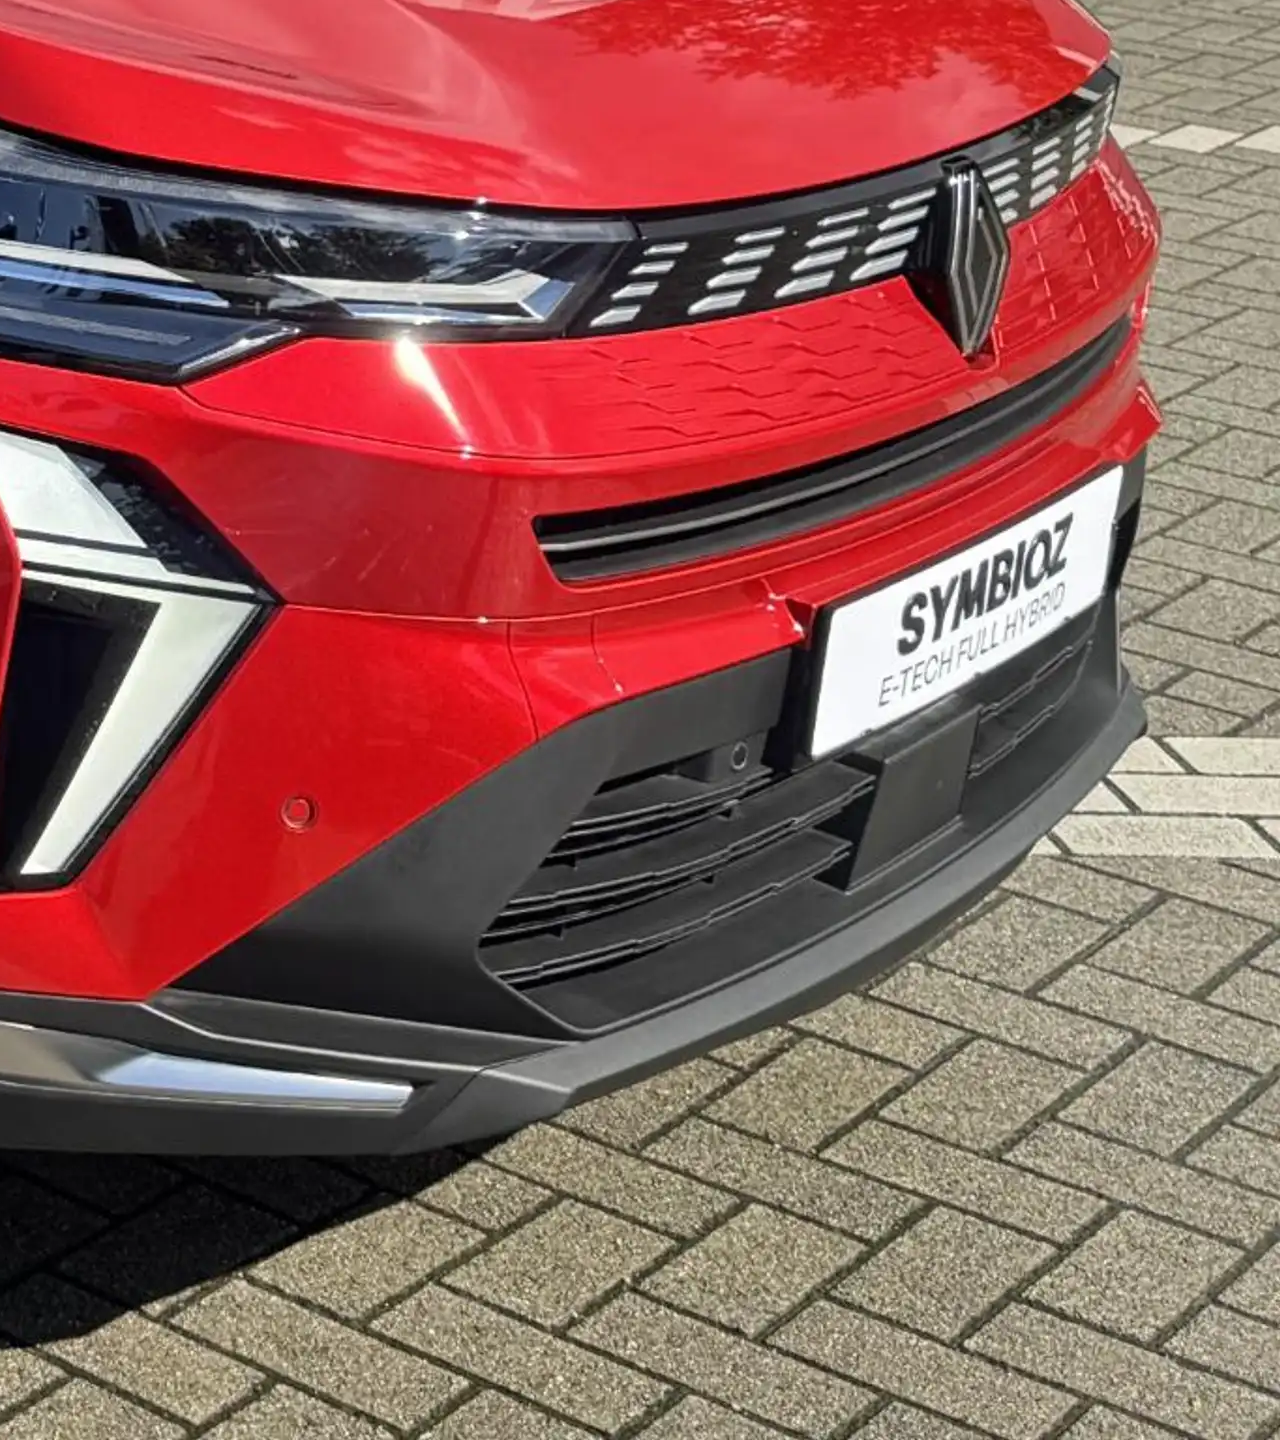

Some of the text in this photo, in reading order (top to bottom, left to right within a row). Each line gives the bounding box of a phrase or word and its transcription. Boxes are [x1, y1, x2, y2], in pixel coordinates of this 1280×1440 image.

[878, 583, 1066, 707] E-TECH FULL HYBRID
[897, 513, 1074, 655] SYMBIOZ
